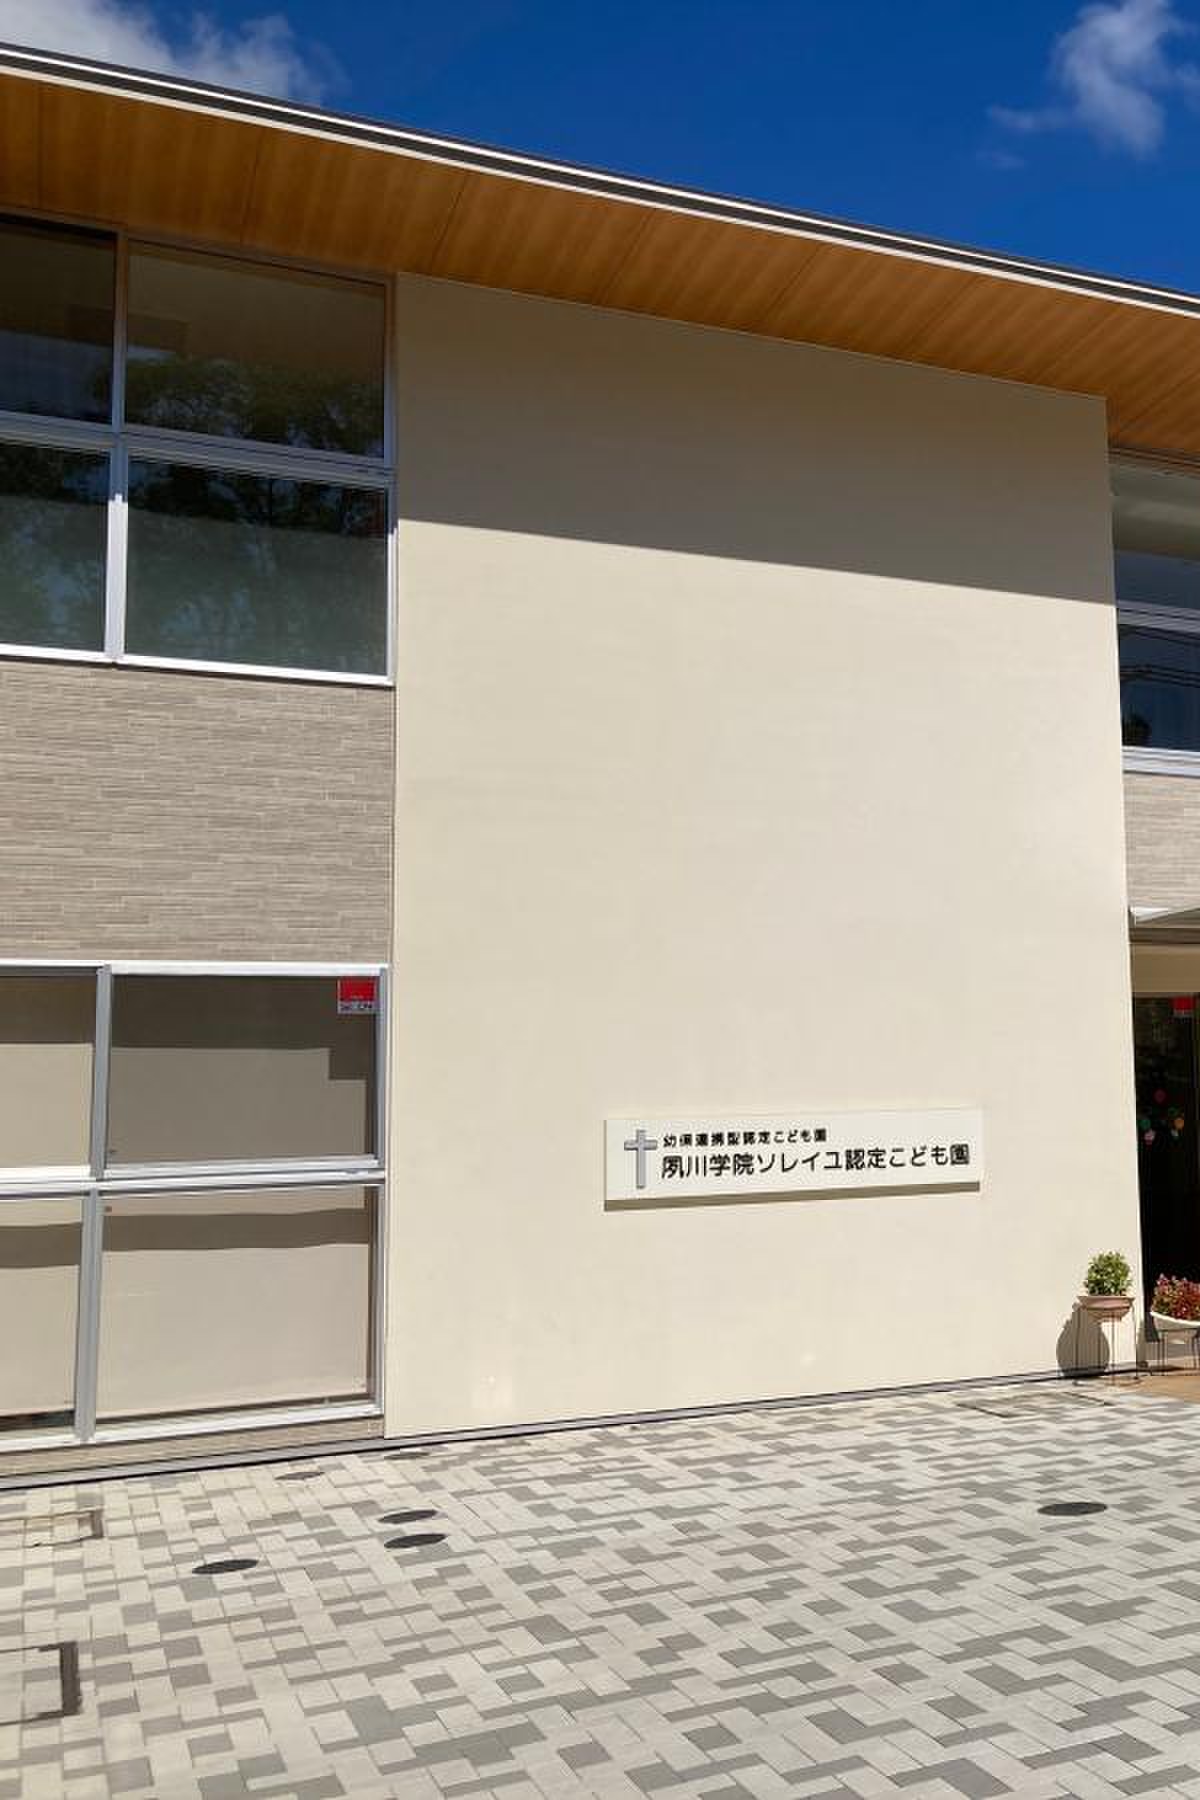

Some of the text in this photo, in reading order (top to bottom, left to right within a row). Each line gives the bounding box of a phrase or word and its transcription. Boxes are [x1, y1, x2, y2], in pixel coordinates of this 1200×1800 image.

[661, 1144, 970, 1179] 夙川学院ソレイユ認定こども園
